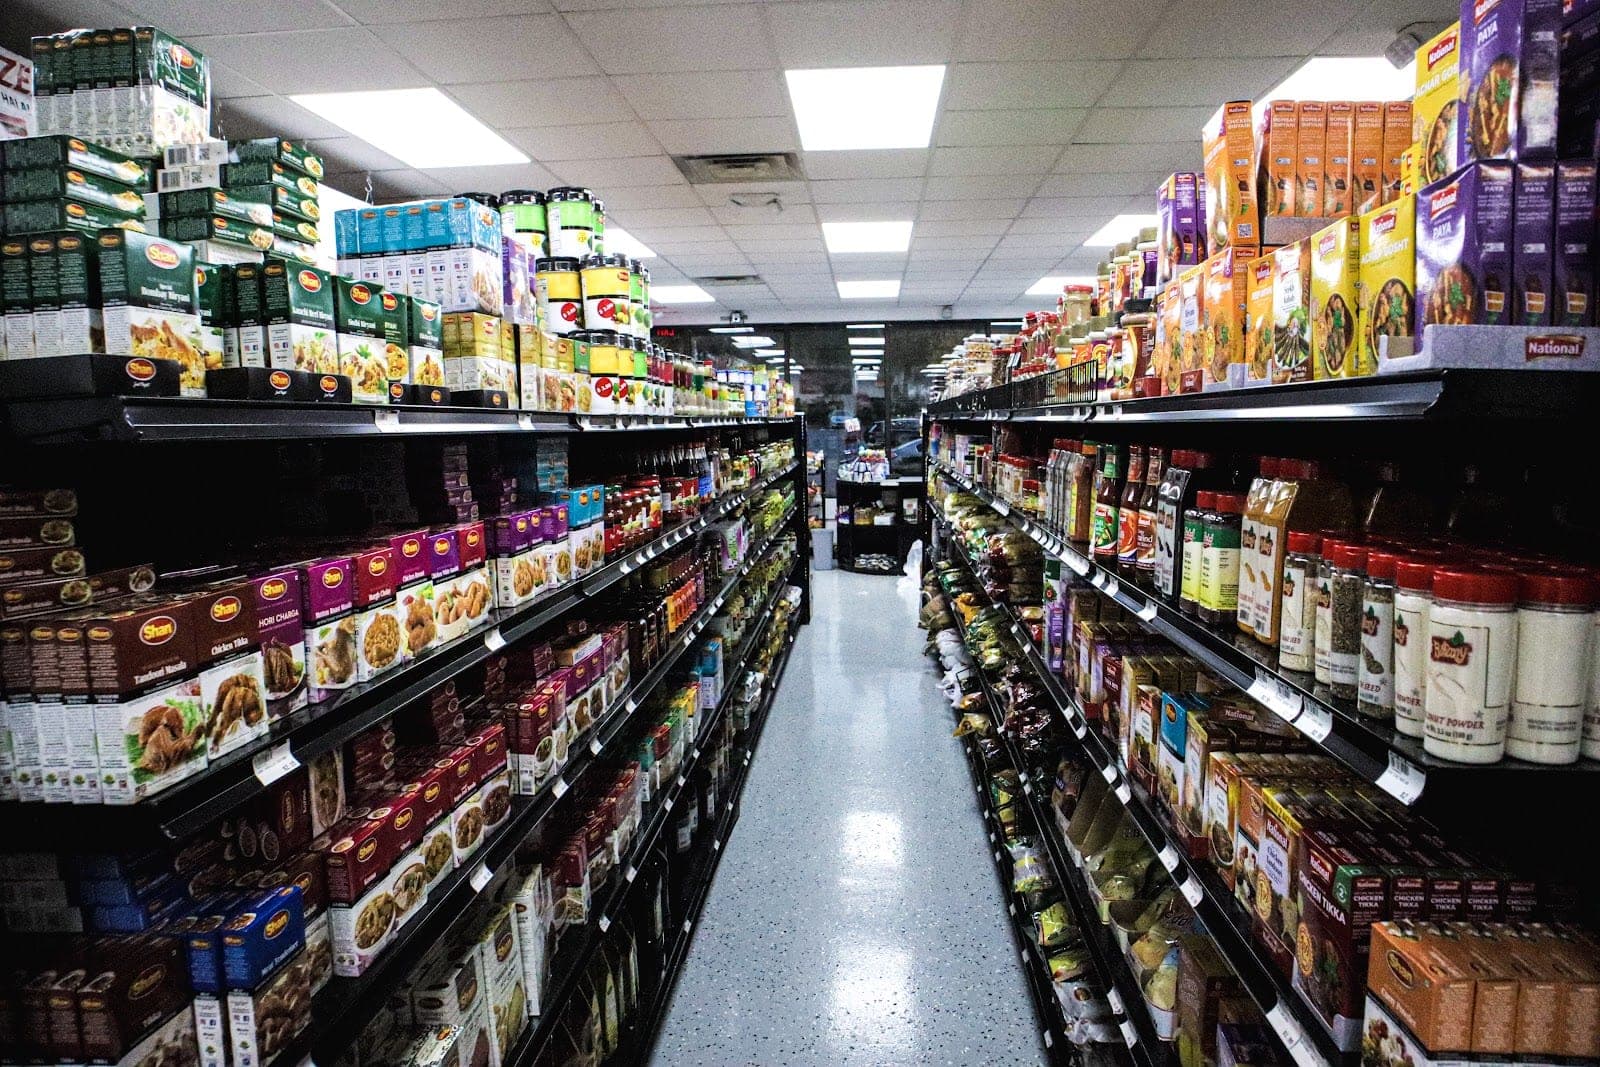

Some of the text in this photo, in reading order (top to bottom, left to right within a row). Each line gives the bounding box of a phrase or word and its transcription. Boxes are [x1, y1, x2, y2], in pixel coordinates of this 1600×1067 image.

[1478, 21, 1498, 45] PAYA
[1433, 222, 1452, 240] PAYA
[352, 288, 369, 302] Shan
[1529, 341, 1579, 355] National
[128, 363, 153, 375] Shan
[262, 583, 284, 596] Shan
[213, 601, 237, 617] Shan
[276, 608, 299, 623] CHARGA
[143, 623, 173, 640] Shan
[212, 641, 234, 656] Chicken
[1225, 709, 1254, 721] National
[1447, 717, 1485, 730] POWDER
[1267, 819, 1288, 849] National
[358, 842, 376, 856] Shan
[1311, 855, 1329, 881] National
[1322, 896, 1346, 926] TIKKA
[265, 914, 288, 936] Shan
